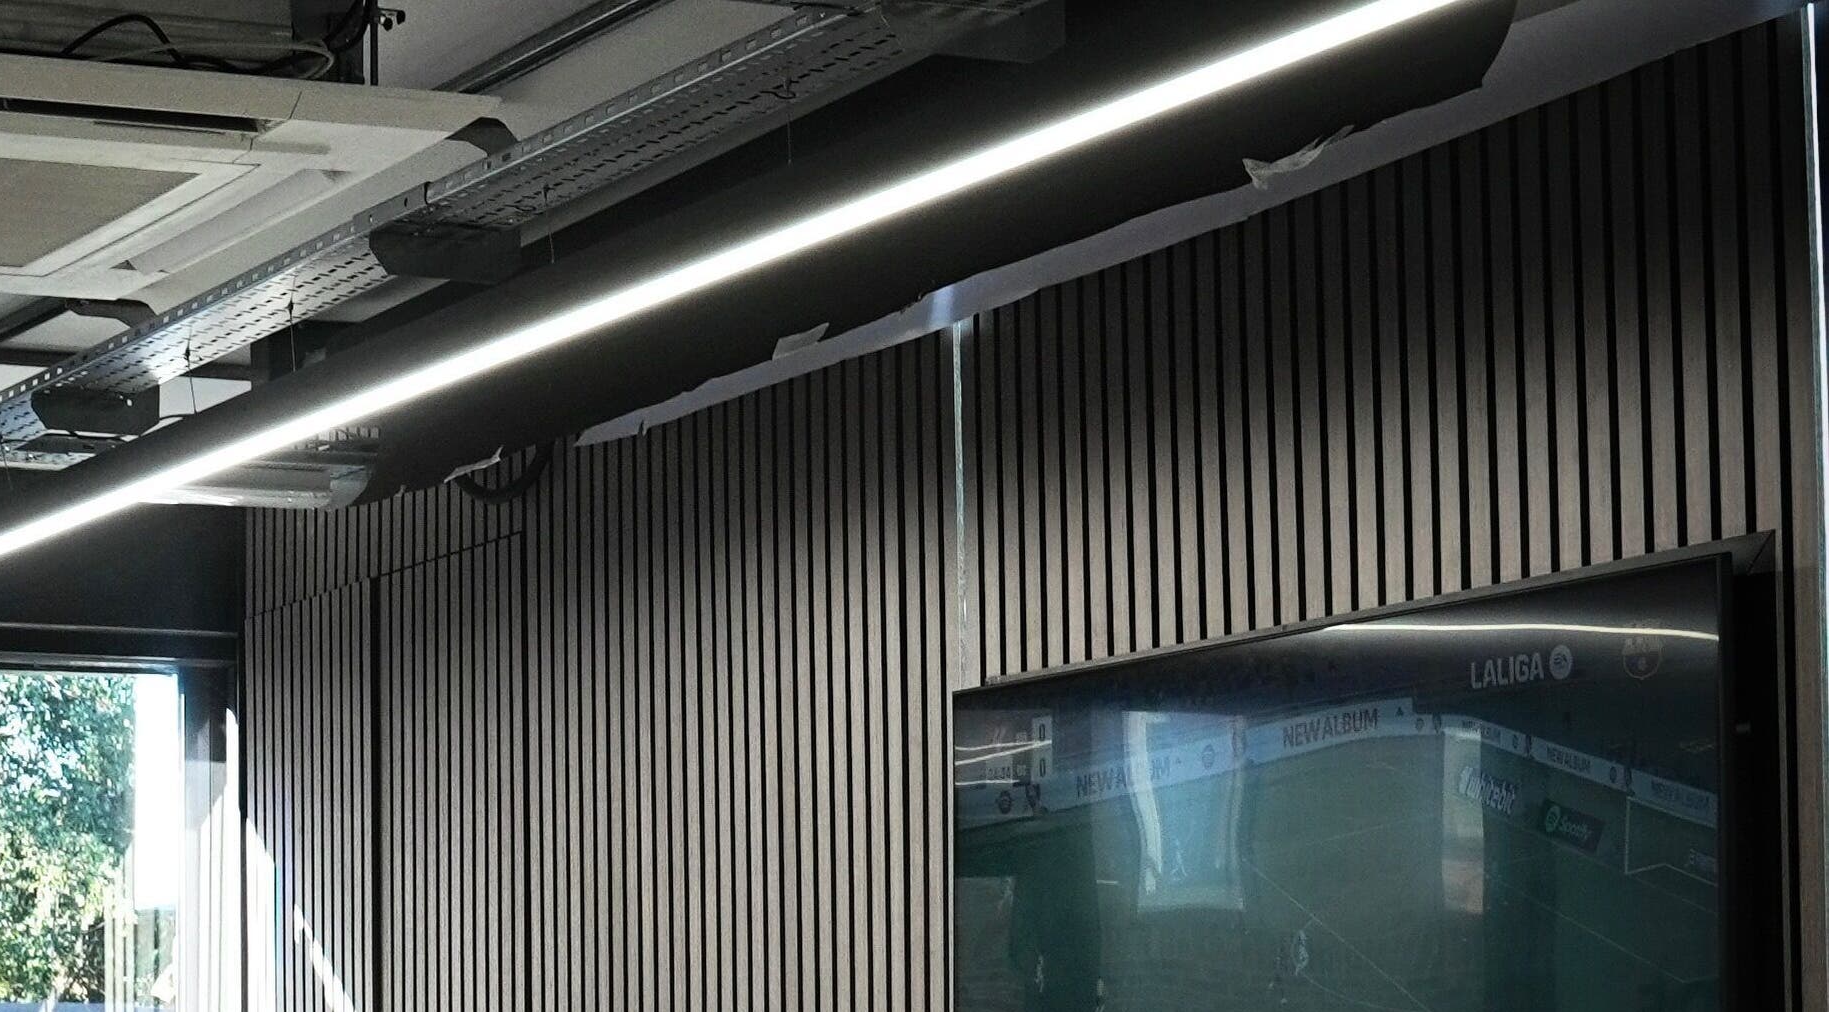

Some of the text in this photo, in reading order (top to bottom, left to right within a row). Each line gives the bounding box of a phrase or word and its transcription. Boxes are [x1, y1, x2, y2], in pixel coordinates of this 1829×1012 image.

[1470, 652, 1545, 689] LALIGA
[1282, 708, 1379, 748] NEW ALBUM
